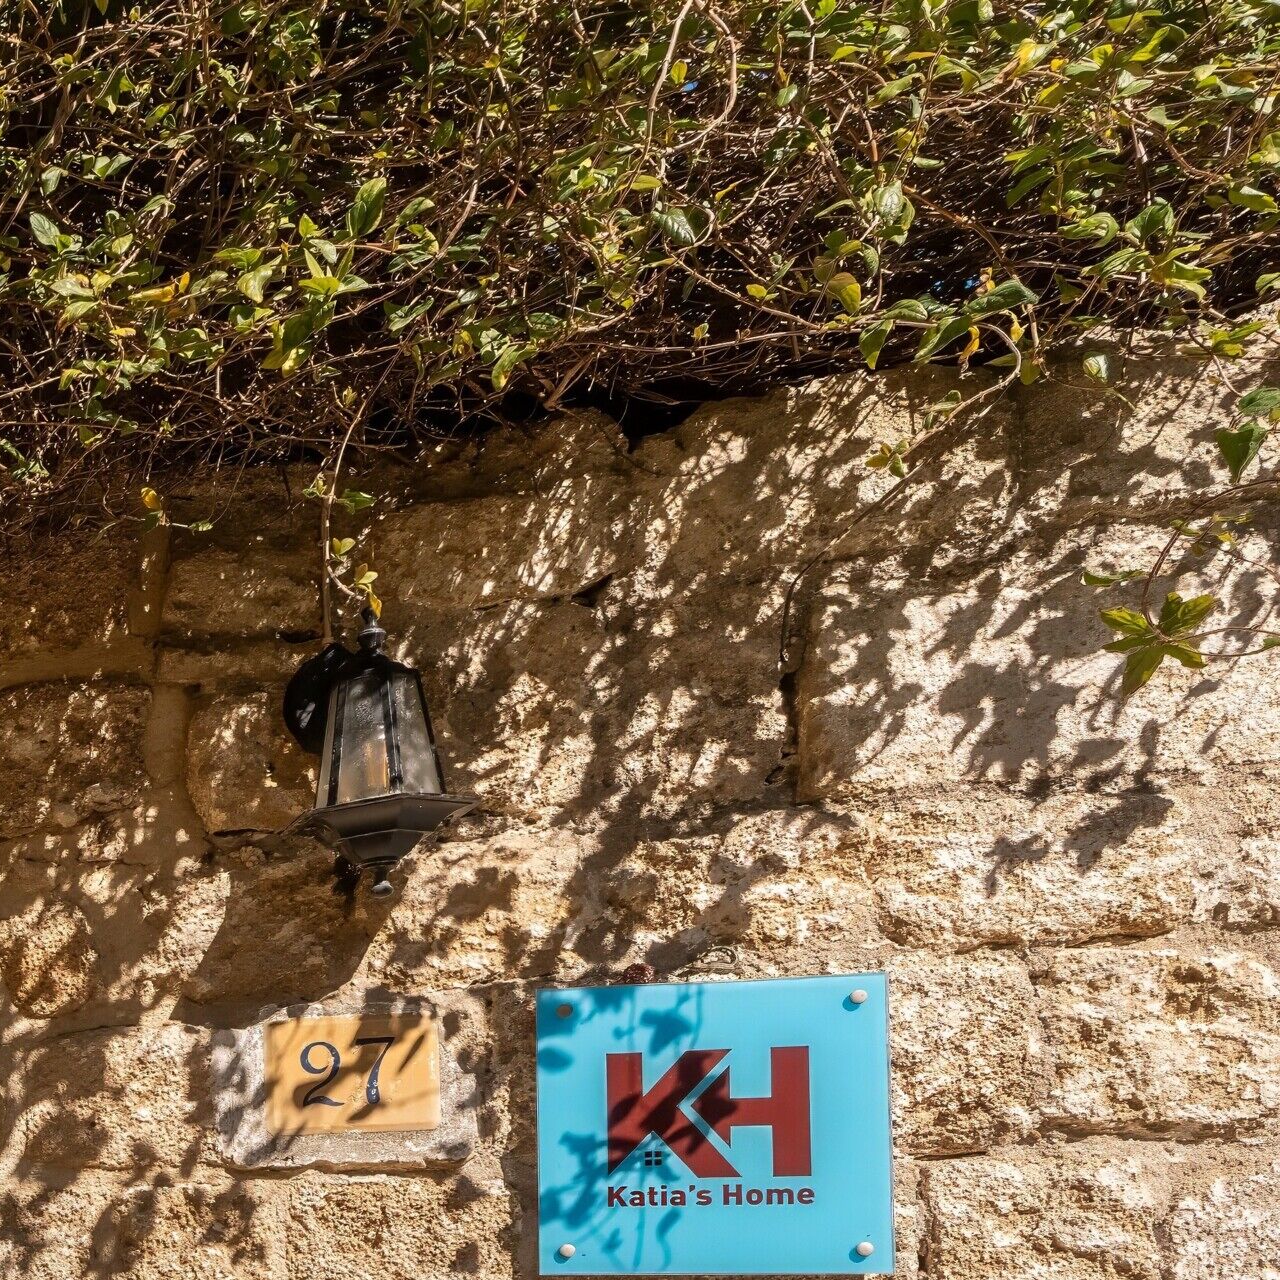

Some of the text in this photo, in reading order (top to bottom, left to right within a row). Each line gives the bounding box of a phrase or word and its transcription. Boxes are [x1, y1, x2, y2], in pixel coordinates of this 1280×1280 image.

[300, 1036, 395, 1107] 27
[606, 1046, 812, 1178] KH
[607, 1184, 815, 1207] Katia's Home
